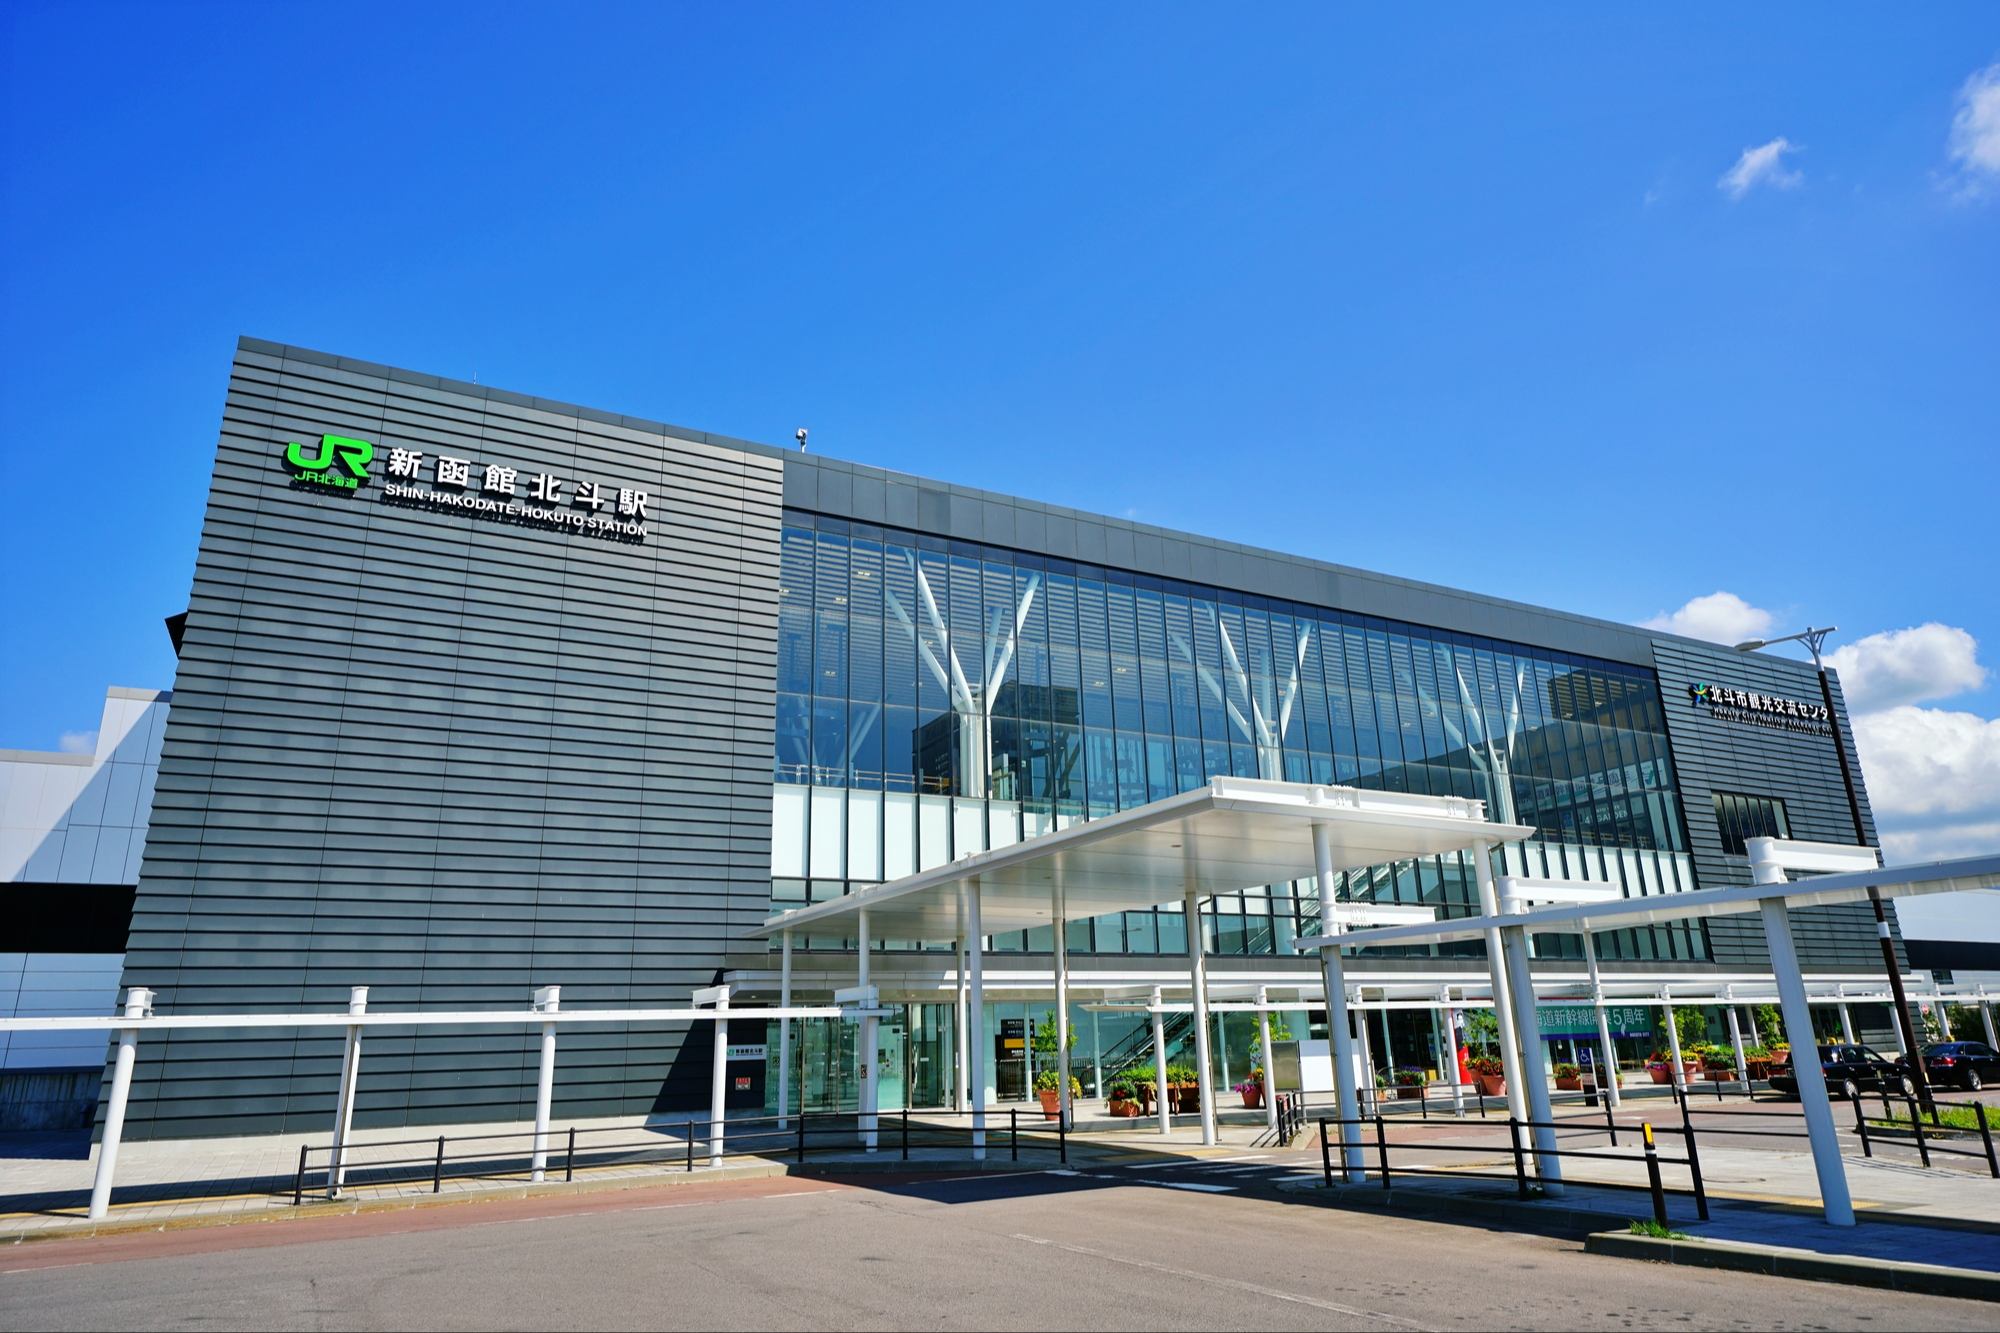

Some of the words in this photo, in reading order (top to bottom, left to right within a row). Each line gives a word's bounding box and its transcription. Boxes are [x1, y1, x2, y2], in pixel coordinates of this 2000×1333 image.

[287, 433, 374, 478] JR
[294, 470, 358, 490] JR北海道
[388, 447, 648, 519] 新函館北斗駅
[385, 483, 584, 527] SHIN-HAKODATE-HOKUTO
[587, 517, 648, 537] STATION
[1710, 684, 1839, 720] 北斗市観光交流センタ
